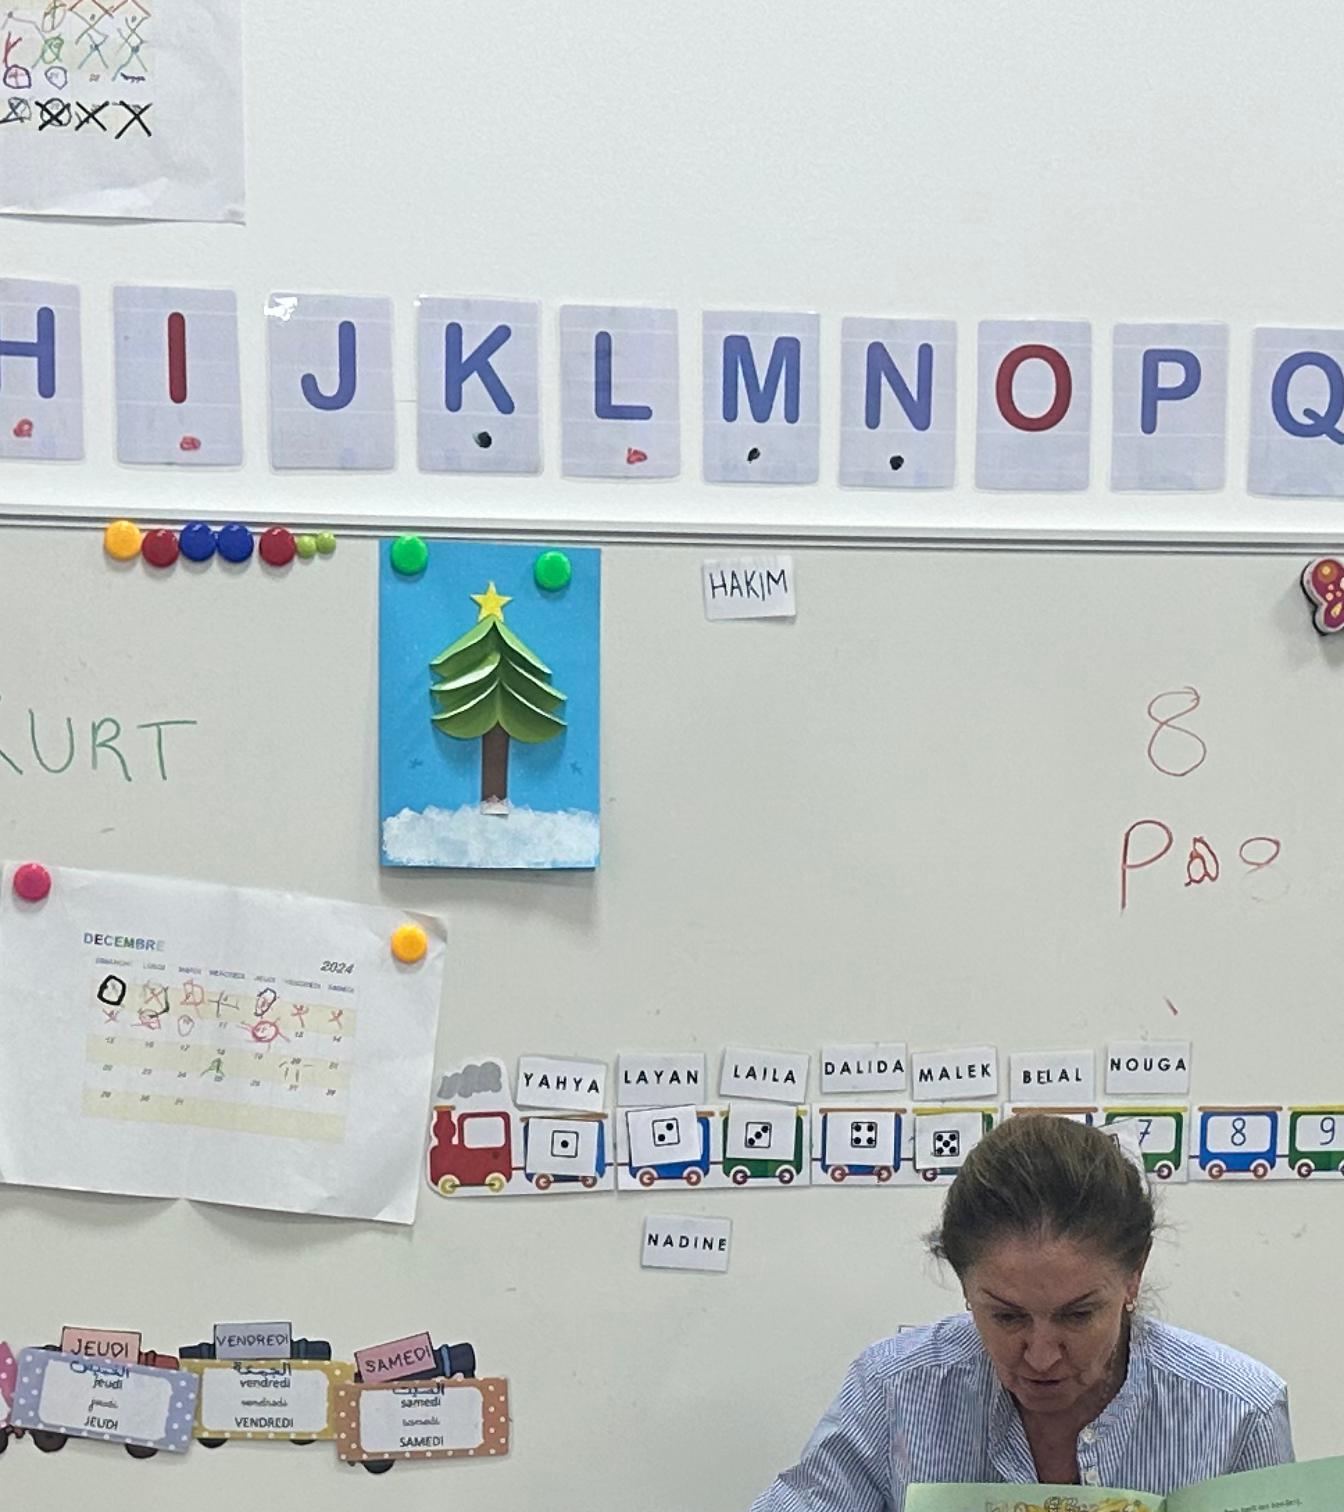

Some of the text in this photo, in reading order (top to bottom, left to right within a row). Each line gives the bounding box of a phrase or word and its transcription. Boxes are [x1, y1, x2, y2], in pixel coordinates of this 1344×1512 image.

[168, 313, 187, 404] I
[301, 320, 356, 411] J
[445, 322, 516, 415] K
[595, 331, 652, 421] L
[723, 336, 800, 424] M
[865, 342, 933, 431] N
[995, 344, 1073, 432] O
[1141, 349, 1202, 436] P
[709, 567, 789, 603] HAKIM
[1147, 686, 1207, 777] 8
[82, 931, 165, 953] DECEMBRE
[320, 959, 355, 976] 2024
[733, 1064, 797, 1085] LAILA
[824, 1058, 905, 1077] DALIDA
[919, 1062, 992, 1084] MALEK
[1110, 1057, 1187, 1074] NOUGA
[523, 1071, 601, 1095] YAHYA
[624, 1068, 699, 1086] LAYAN
[1023, 1067, 1082, 1084] BELAL
[1138, 1118, 1152, 1147] 7
[1230, 1118, 1247, 1147] 8
[1319, 1117, 1336, 1147] 9
[647, 1233, 727, 1252] NADINE
[70, 1338, 129, 1358] JEUDI
[216, 1333, 289, 1348] VENDREDI
[365, 1346, 430, 1374] SAMEDI
[240, 1377, 291, 1388] vendredi
[401, 1396, 440, 1408] samedi
[84, 1416, 118, 1430] JEUDI
[235, 1416, 294, 1428] VENDREDI
[399, 1435, 444, 1448] SAMEDI
